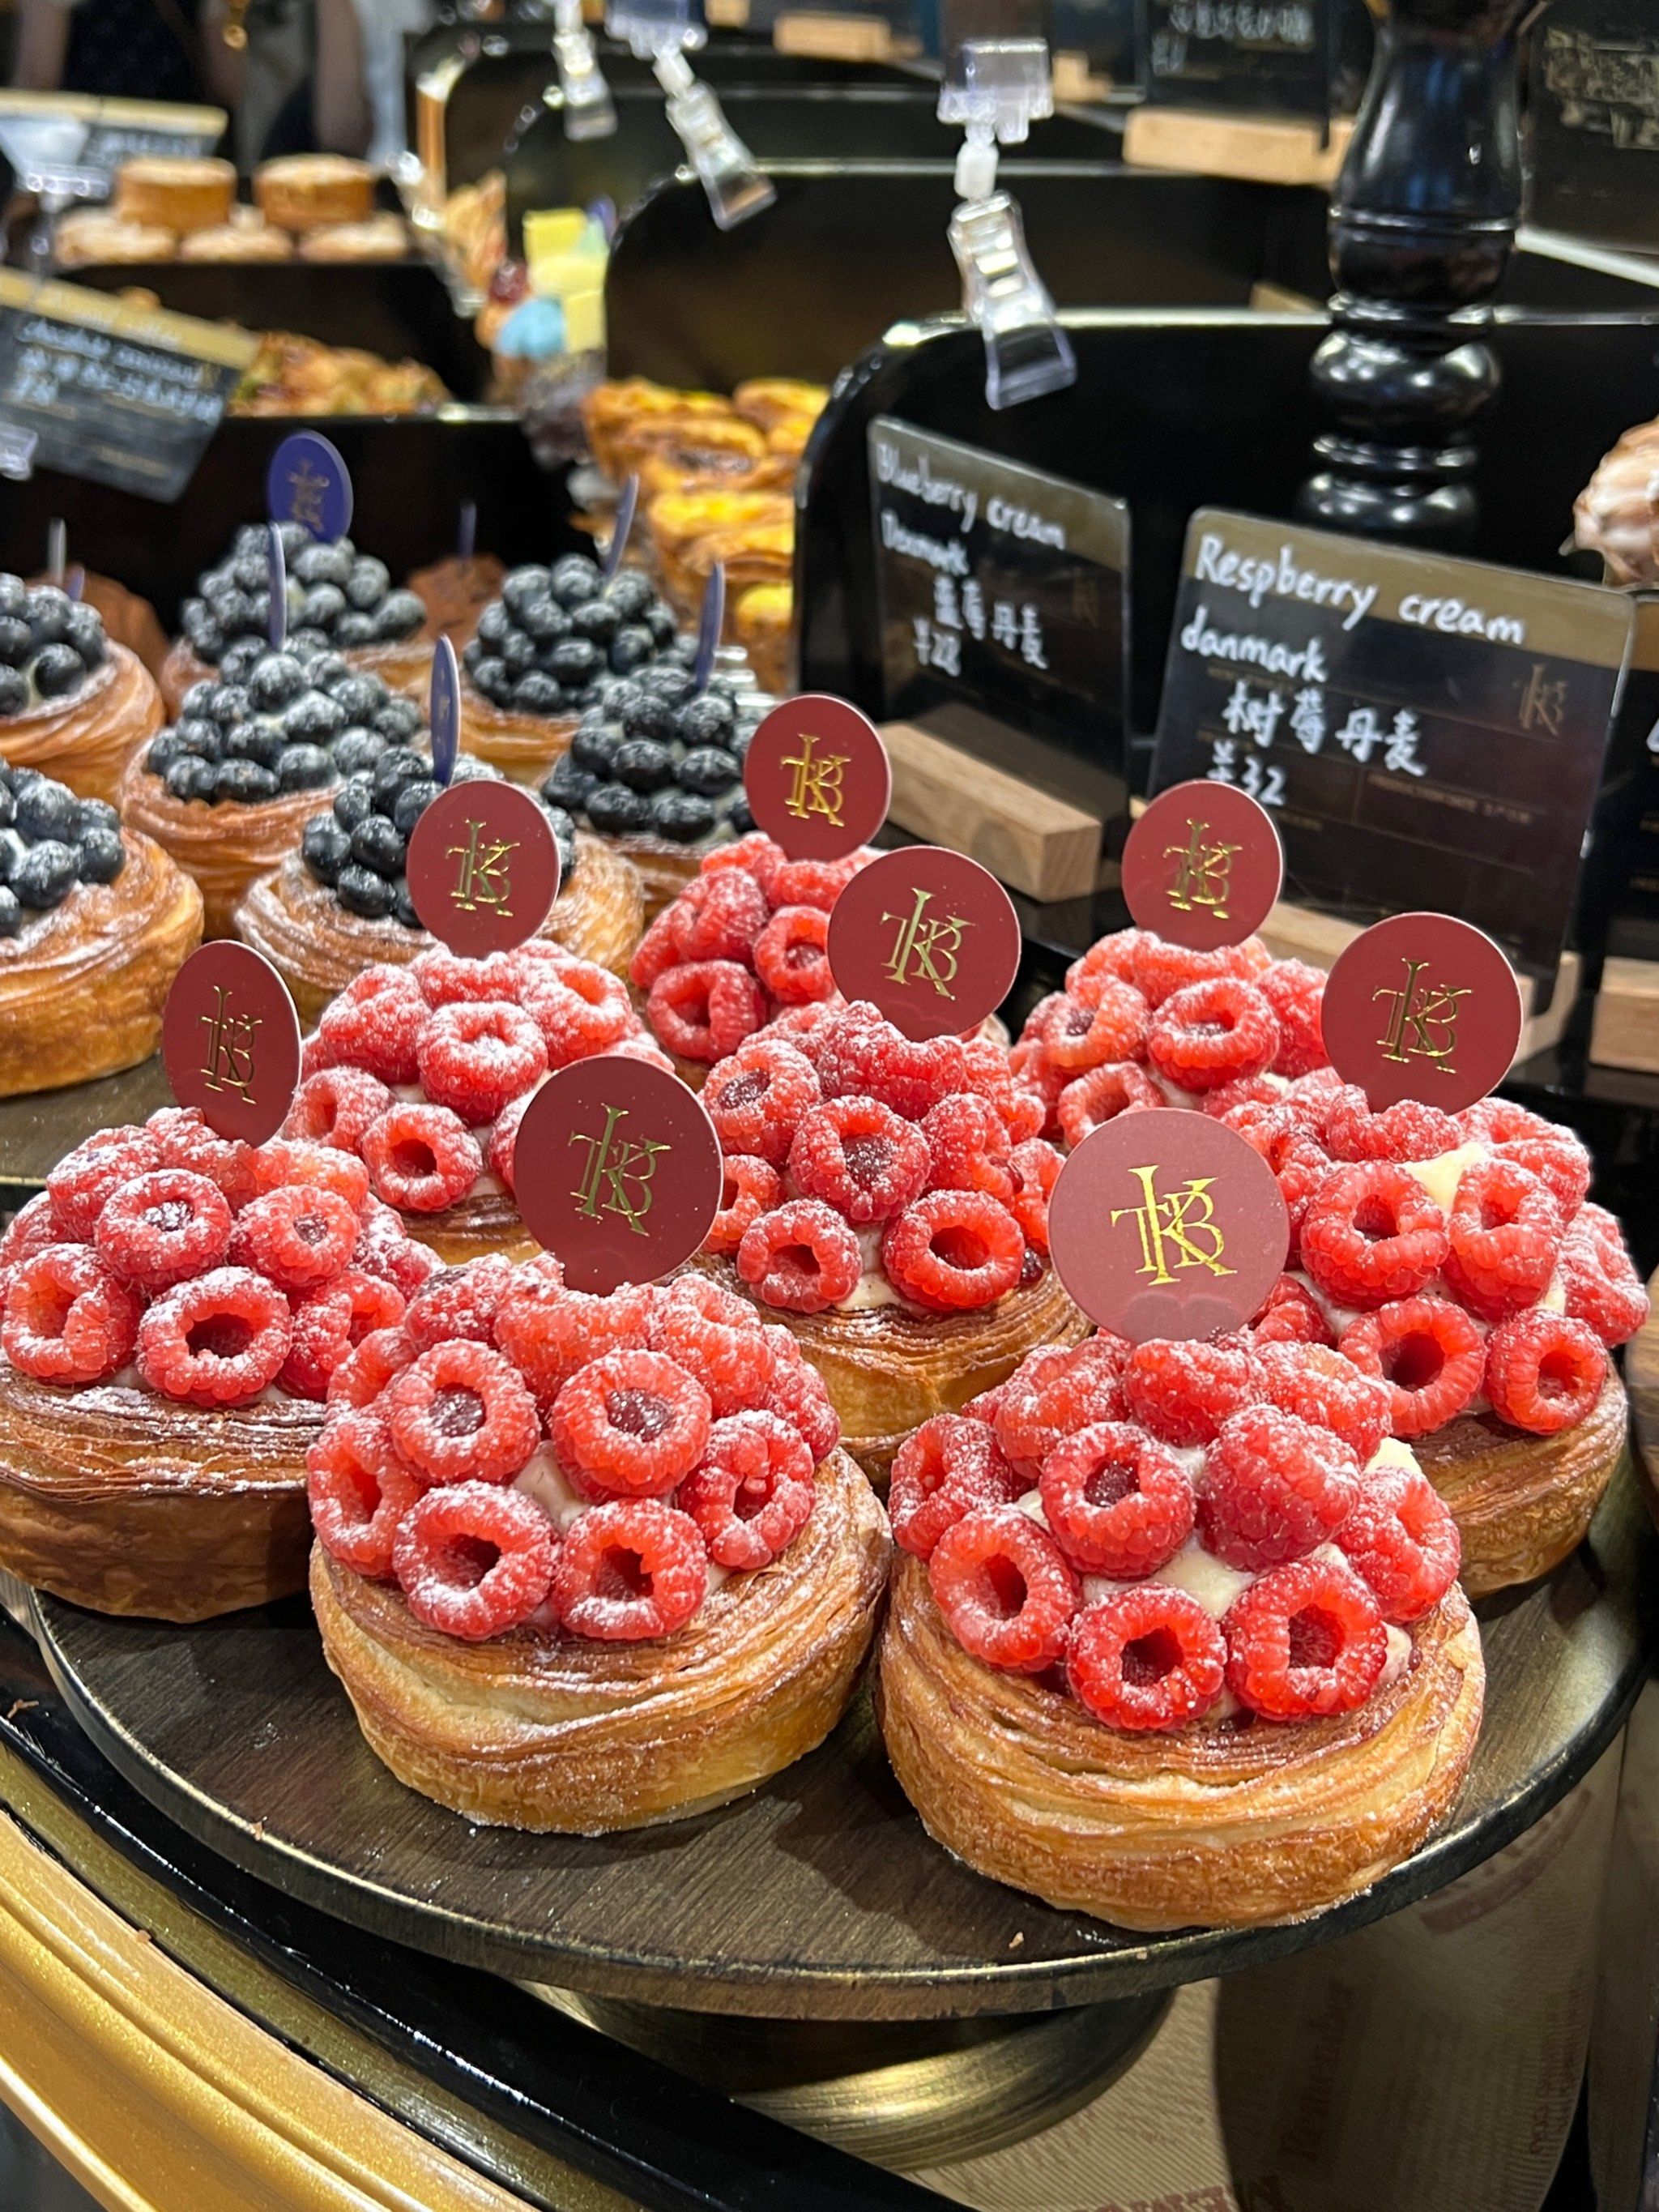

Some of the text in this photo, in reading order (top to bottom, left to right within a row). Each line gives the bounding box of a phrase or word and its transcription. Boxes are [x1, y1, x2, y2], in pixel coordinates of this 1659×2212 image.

[1194, 534, 1525, 646] Respberry cream
[1179, 604, 1328, 683] danmark
